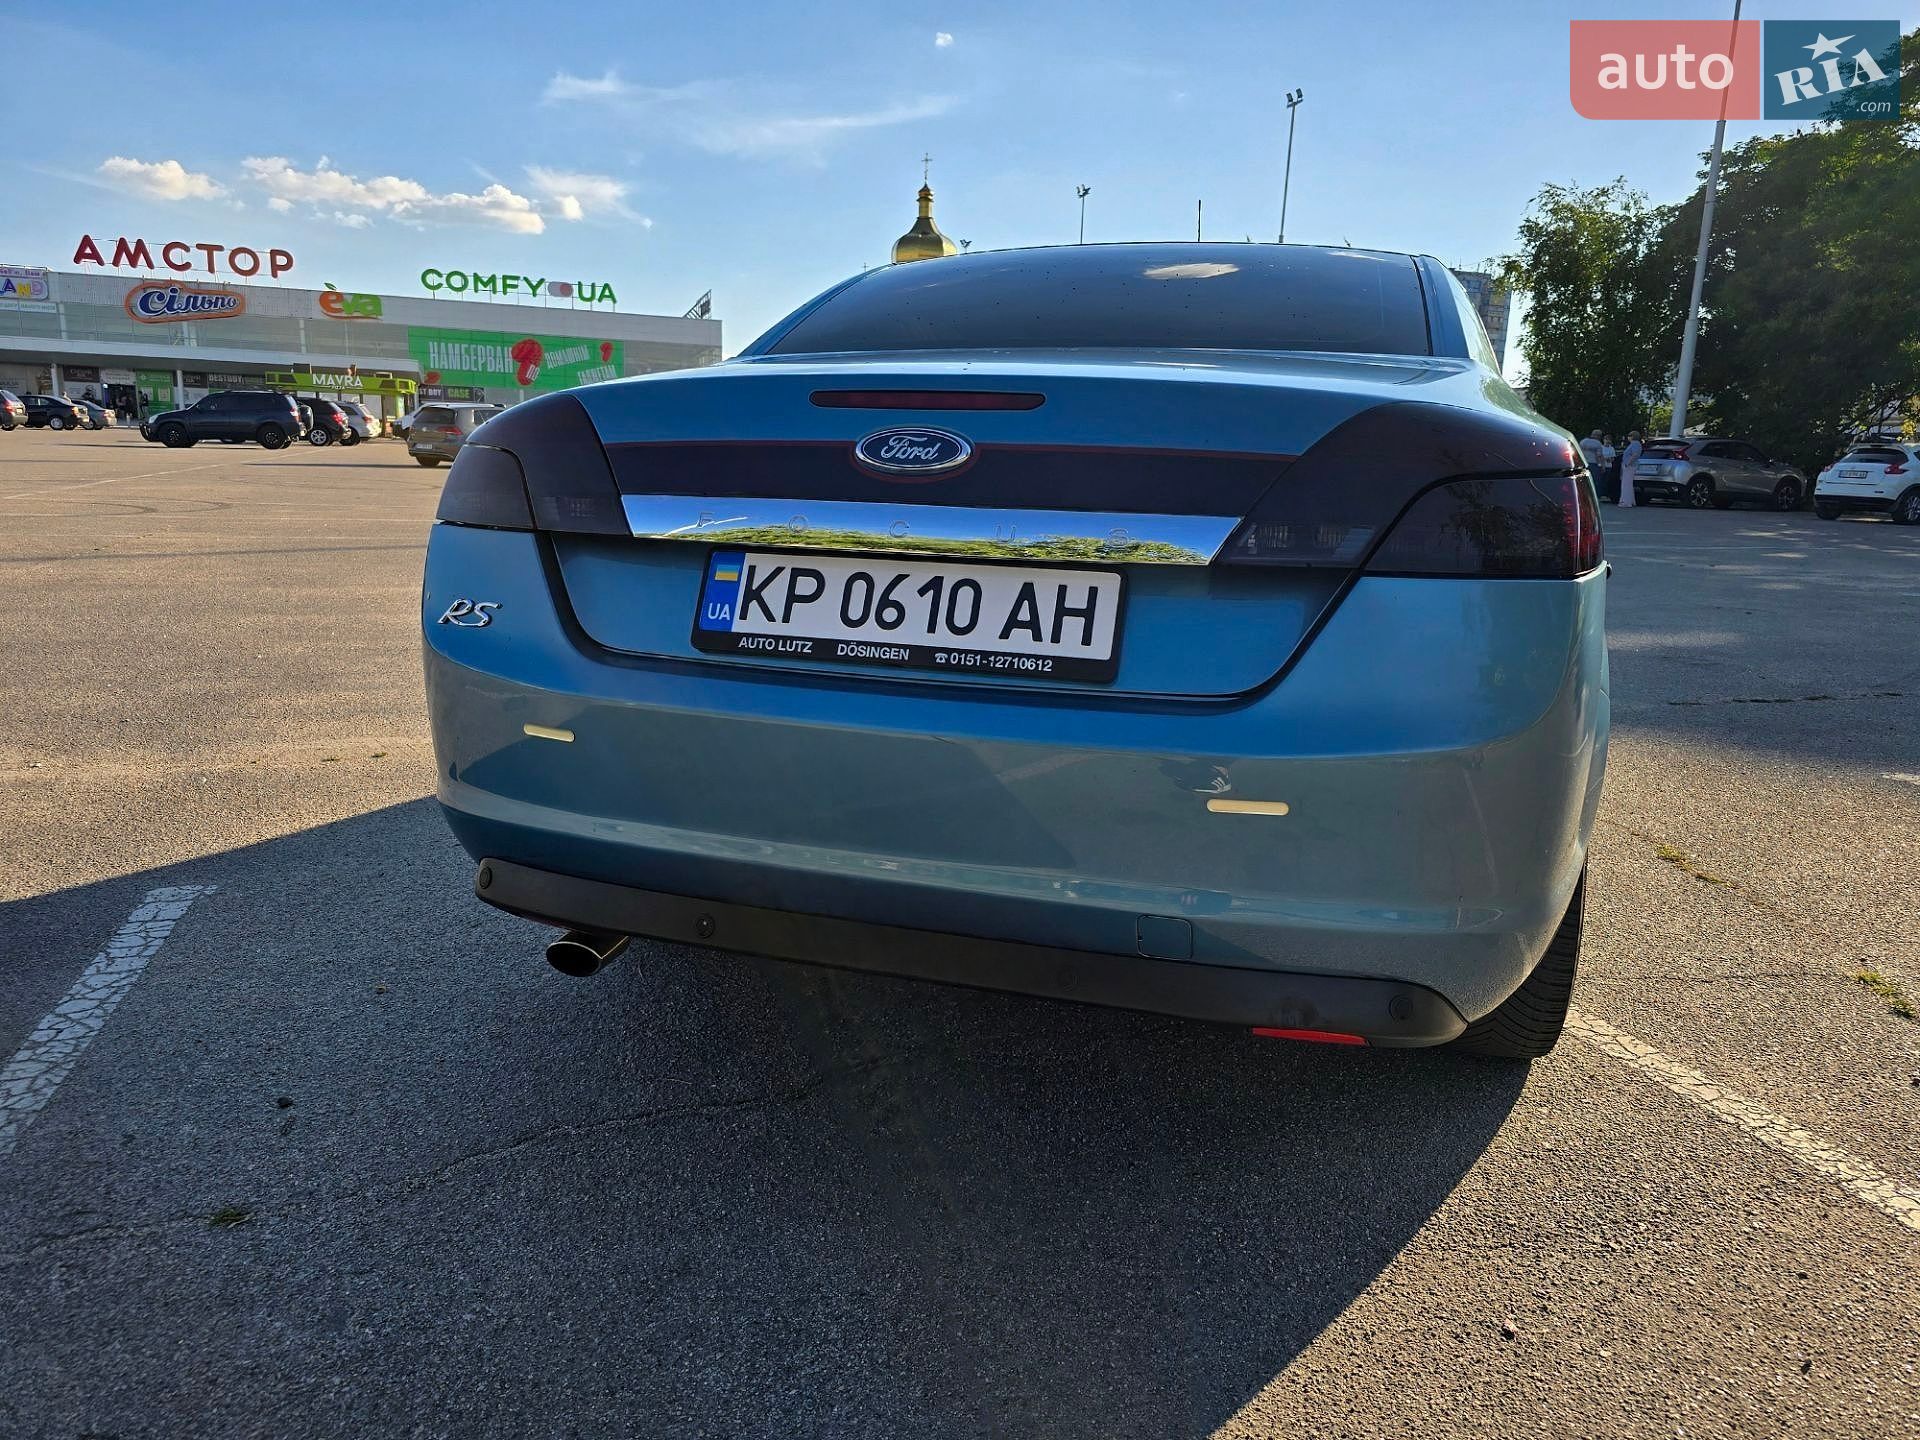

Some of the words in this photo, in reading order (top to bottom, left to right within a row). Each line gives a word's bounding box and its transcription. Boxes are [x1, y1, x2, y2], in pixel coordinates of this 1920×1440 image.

[73, 234, 294, 278] АМСТОР
[139, 287, 238, 315] Сільпо
[420, 268, 545, 297] COMFY
[577, 280, 617, 304] UA
[428, 341, 514, 374] НАМБЕРВАН
[312, 373, 364, 388] MAVRA
[880, 435, 941, 460] Ford
[437, 599, 499, 626] RS
[707, 602, 731, 622] UA
[738, 564, 827, 625] KP
[839, 571, 983, 637] 0610
[998, 582, 1099, 647] AH
[738, 637, 776, 651] AUTO
[778, 639, 814, 653] LUTZ
[837, 641, 910, 661] DÖSINGEN
[950, 652, 1053, 672] 0151-12710612
